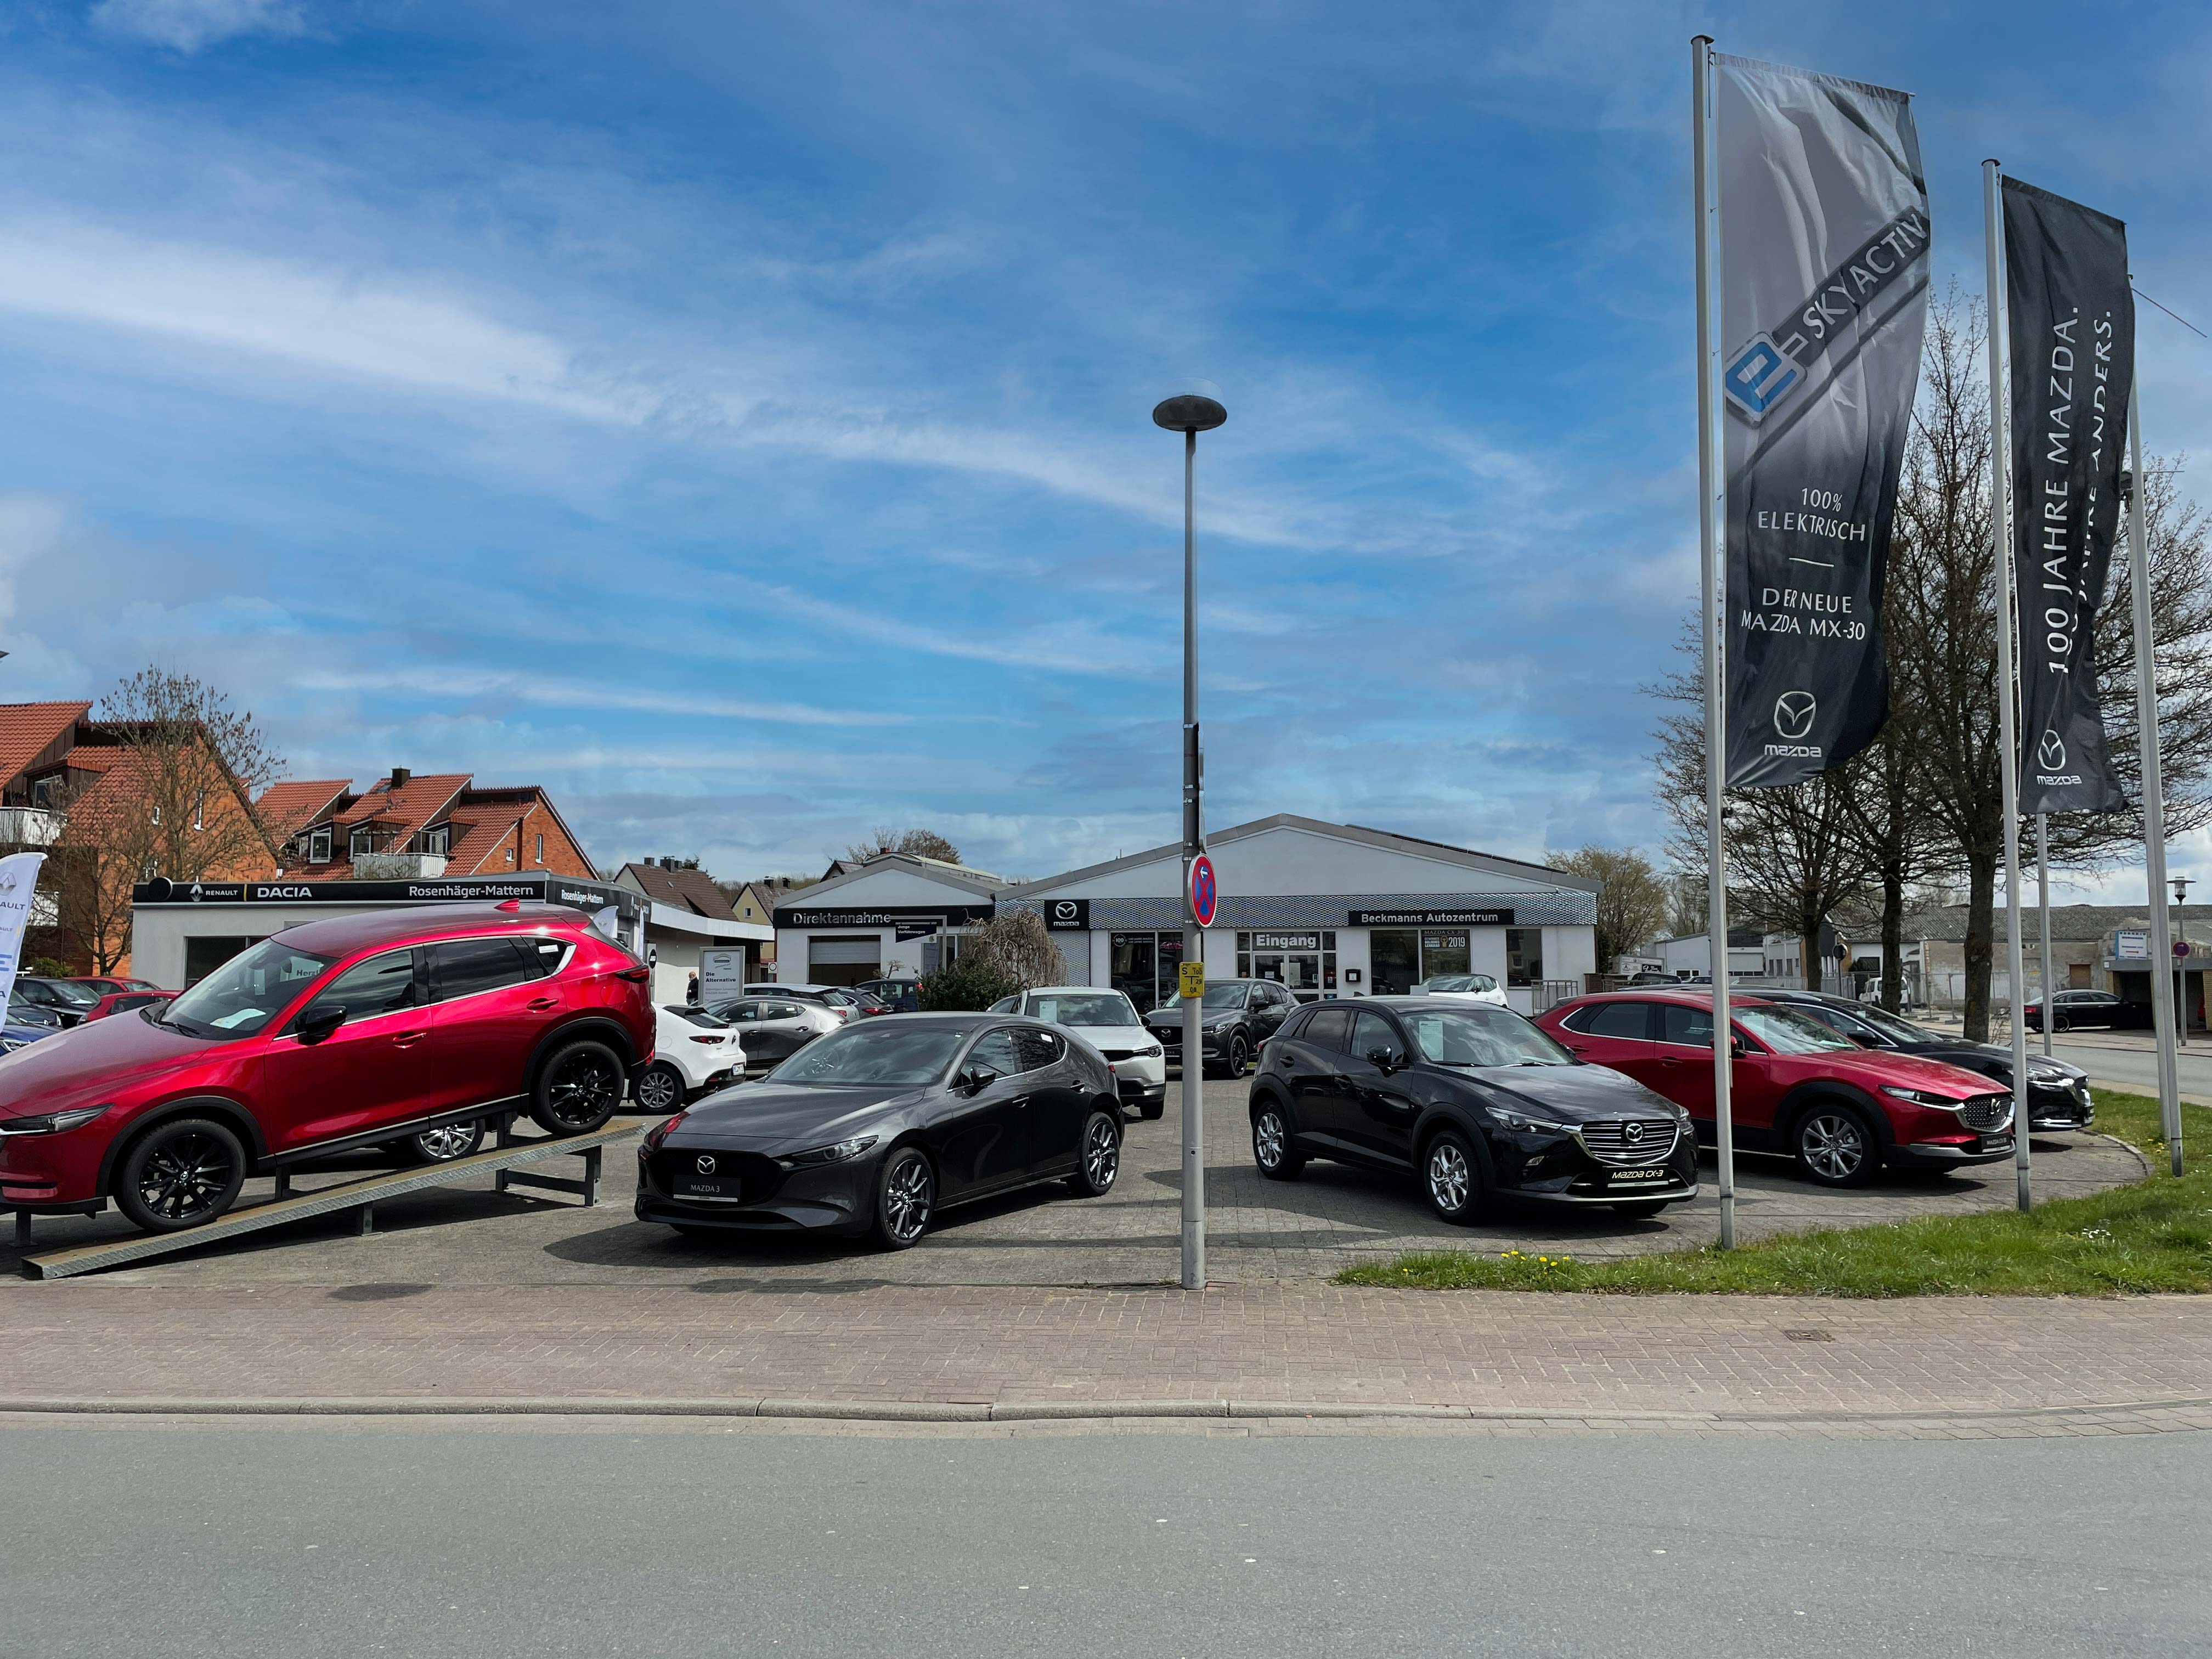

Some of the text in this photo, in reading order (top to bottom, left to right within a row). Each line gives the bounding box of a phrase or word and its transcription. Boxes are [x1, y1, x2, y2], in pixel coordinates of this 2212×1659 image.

[2042, 307, 2078, 674] 100 JAHRE MAZDA.
[1802, 487, 1843, 512] 100%
[1758, 510, 1865, 541] ELEKTRISCH
[1762, 588, 1853, 614] DER NEUE
[1741, 610, 1866, 640] MAZDA MX-30
[257, 887, 312, 898] DACIA
[409, 885, 534, 899] Rosenhäger-Mattern
[0, 901, 26, 910] AULT
[793, 912, 891, 924] Direktannahme
[1361, 913, 1498, 923] Beckmanns Autozentrum
[1256, 934, 1316, 948] Eingang
[1448, 936, 1465, 947] 2019
